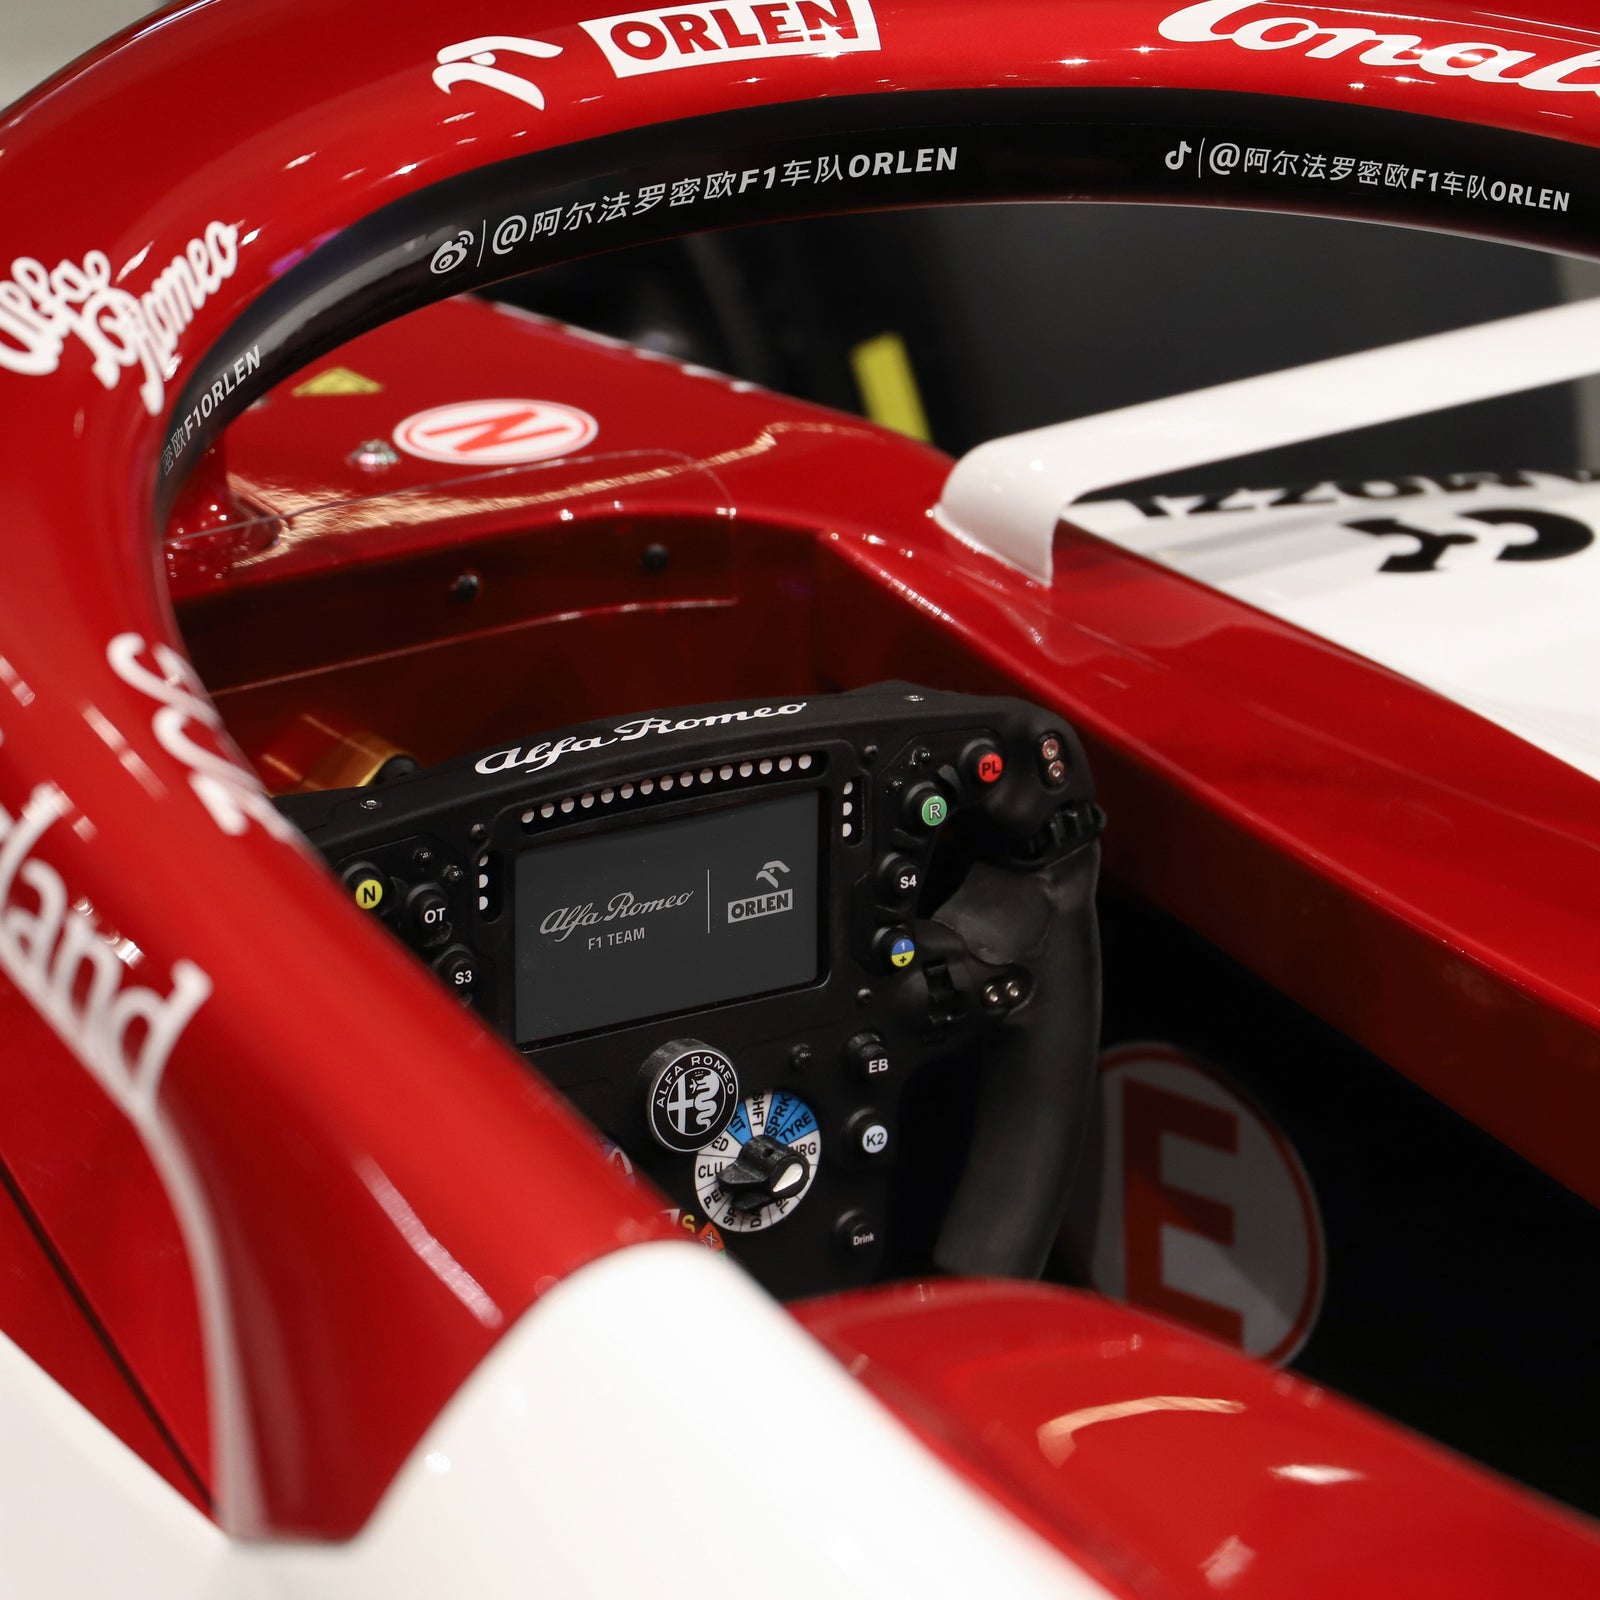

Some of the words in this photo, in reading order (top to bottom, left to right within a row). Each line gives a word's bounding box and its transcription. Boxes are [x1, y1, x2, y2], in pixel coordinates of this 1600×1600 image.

[610, 0, 859, 61] ORLEN
[82, 220, 239, 415] Romeo
[474, 736, 619, 775] Alfa
[613, 702, 808, 742] Romeo
[981, 759, 1001, 778] PL
[928, 803, 942, 820] R
[900, 874, 918, 889] S4
[363, 885, 377, 904] N
[730, 891, 789, 920] ORLEN
[424, 907, 447, 924] OT
[539, 902, 605, 943] Alfa
[603, 889, 695, 922] Romeo
[588, 936, 603, 951] F1
[607, 926, 646, 947] TEAM
[454, 970, 473, 986] S3
[868, 1058, 889, 1074] EB
[656, 1065, 684, 1108] ALFA
[691, 1055, 735, 1095] ROMEO
[779, 1111, 813, 1143] TYRE
[866, 1133, 885, 1147] K2
[1121, 1075, 1244, 1352] E
[853, 1232, 875, 1246] Drink
